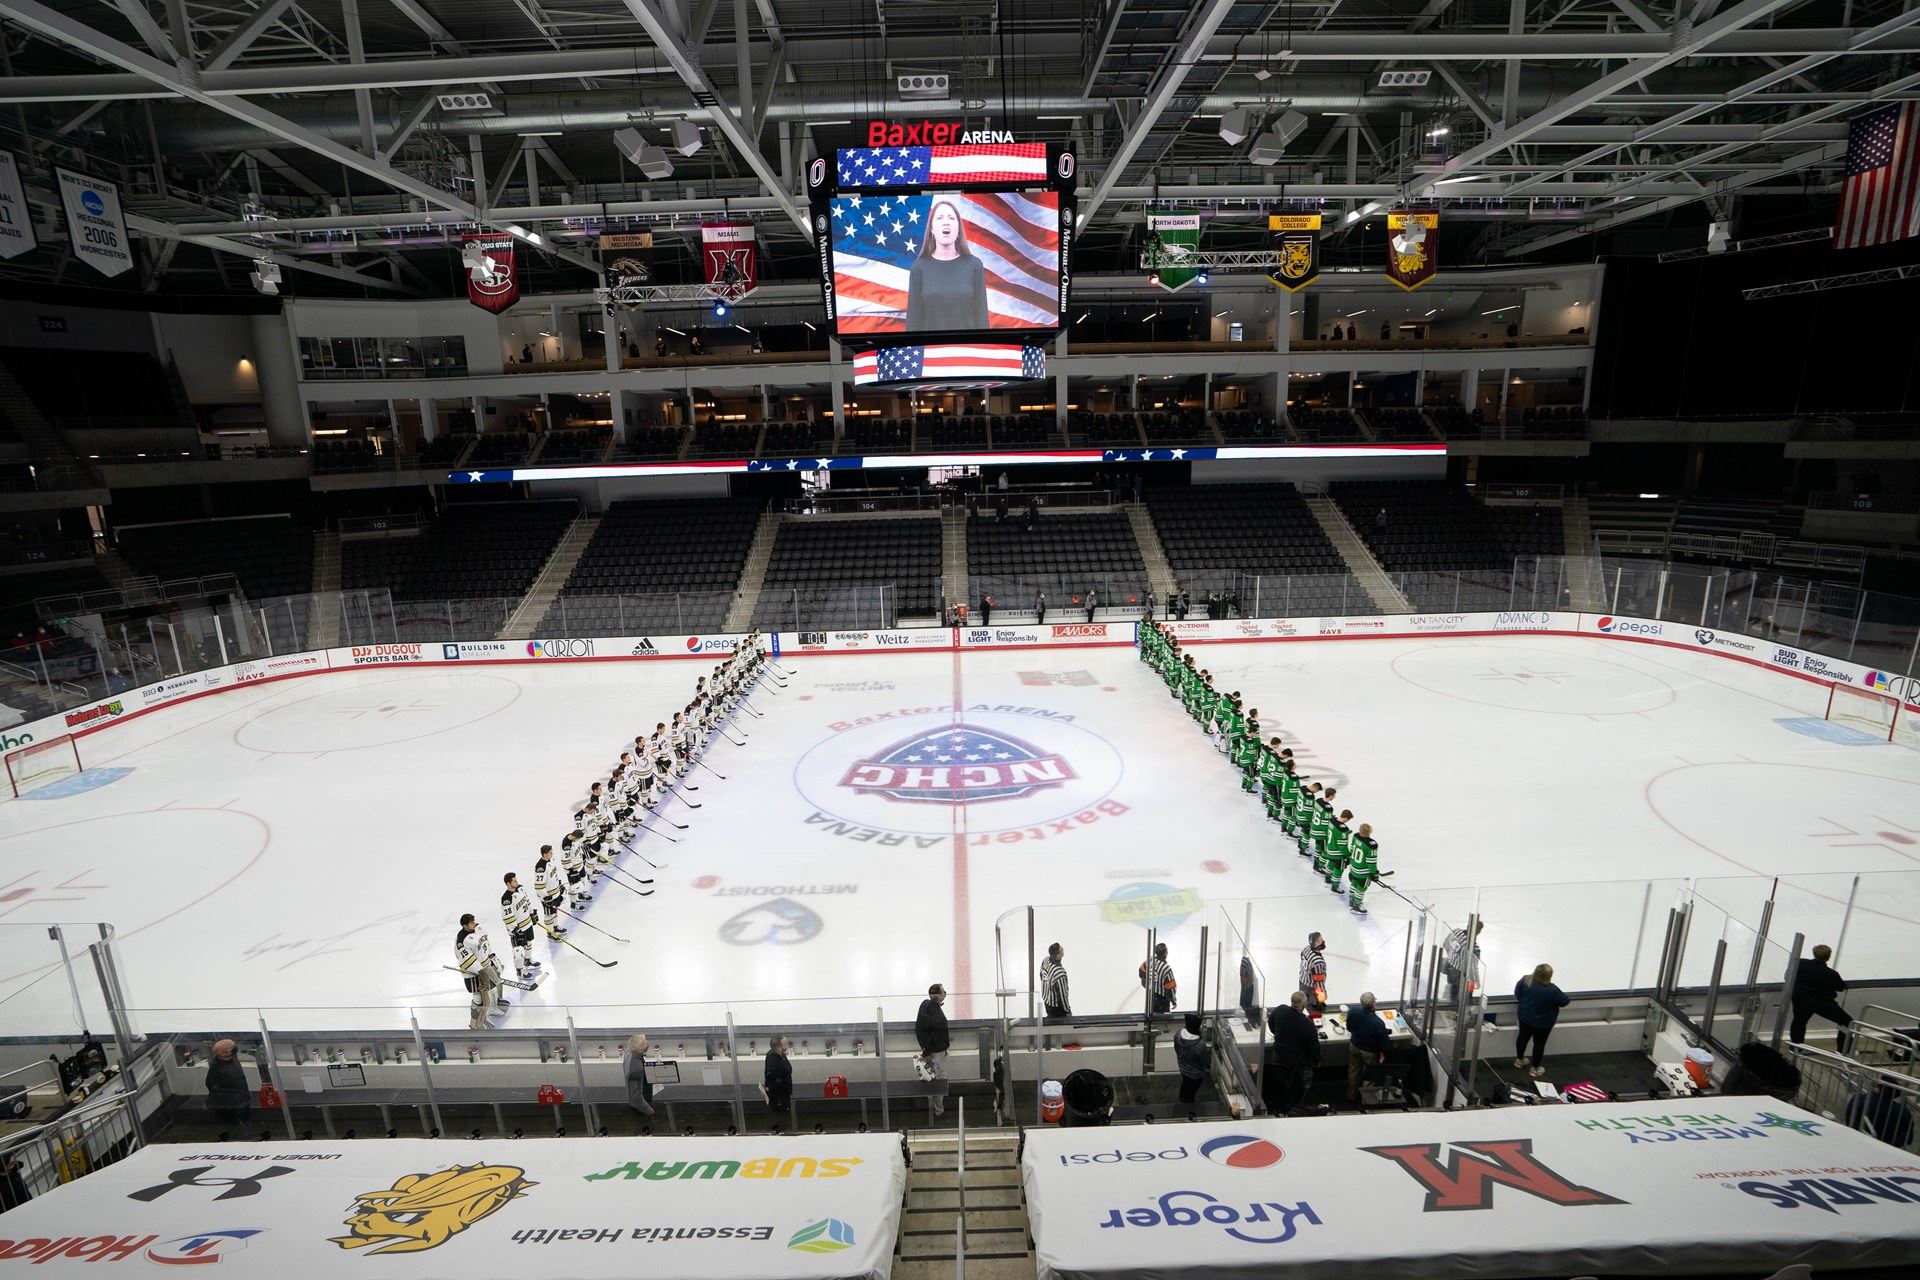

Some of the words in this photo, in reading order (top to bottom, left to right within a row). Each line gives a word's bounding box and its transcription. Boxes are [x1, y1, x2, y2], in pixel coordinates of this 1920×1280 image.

[868, 119, 961, 147] Baxter
[961, 130, 1015, 144] ARENA
[81, 179, 93, 189] ICE
[92, 183, 113, 195] HOCKEY
[77, 213, 117, 228] REGIONAL
[84, 225, 118, 247] 2006
[80, 243, 128, 260] WORCESTER
[1854, 500, 1873, 508] 109
[26, 551, 46, 560] 124
[1409, 616, 1426, 625] SUN
[1428, 616, 1446, 624] TAN
[1446, 615, 1465, 623] CITY
[996, 630, 1016, 638] Enjoy
[1619, 622, 1663, 635] pepsi
[875, 634, 910, 645] Weitz
[996, 634, 1038, 643] Responsibly
[1714, 637, 1756, 652] METHODIST
[352, 646, 373, 658] DJ's
[375, 643, 422, 655] DUGOUT
[461, 643, 506, 651] BUILDING
[543, 638, 595, 658] CURZON
[631, 648, 660, 656] adidas
[1778, 648, 1798, 660] BUD
[353, 655, 391, 664] SPORTS
[392, 654, 409, 662] BAR
[1773, 655, 1800, 668] LIGHT
[1804, 656, 1828, 669] Enjoy
[236, 671, 266, 682] MAVS
[1803, 663, 1853, 683] Responsibly
[142, 687, 157, 698] BIG
[167, 678, 198, 690] NEBRASKA
[1888, 676, 1920, 705] CUR
[827, 704, 953, 732] Baxter
[967, 704, 1076, 723] ARENA
[851, 756, 1067, 788] NCHC
[969, 798, 1131, 846] Baxter
[803, 811, 945, 849] ARENA
[1351, 844, 1364, 864] 10
[712, 883, 859, 897] METHODIST
[504, 908, 512, 916] 28
[460, 950, 469, 959] 15
[1574, 1113, 1738, 1131] HEALTH
[1624, 1126, 1770, 1144] MERCY
[178, 1153, 271, 1162] ARMOUR
[271, 1152, 343, 1161] UNDER
[1061, 1146, 1189, 1167] pepsi
[583, 1156, 865, 1183] SUBWAY
[1696, 1169, 1782, 1180] WORKDAY
[1786, 1167, 1817, 1177] THE
[1099, 1189, 1324, 1244] Kroger
[511, 1226, 622, 1245] Health
[630, 1224, 774, 1243] Essentia
[0, 1234, 160, 1264] Holid
